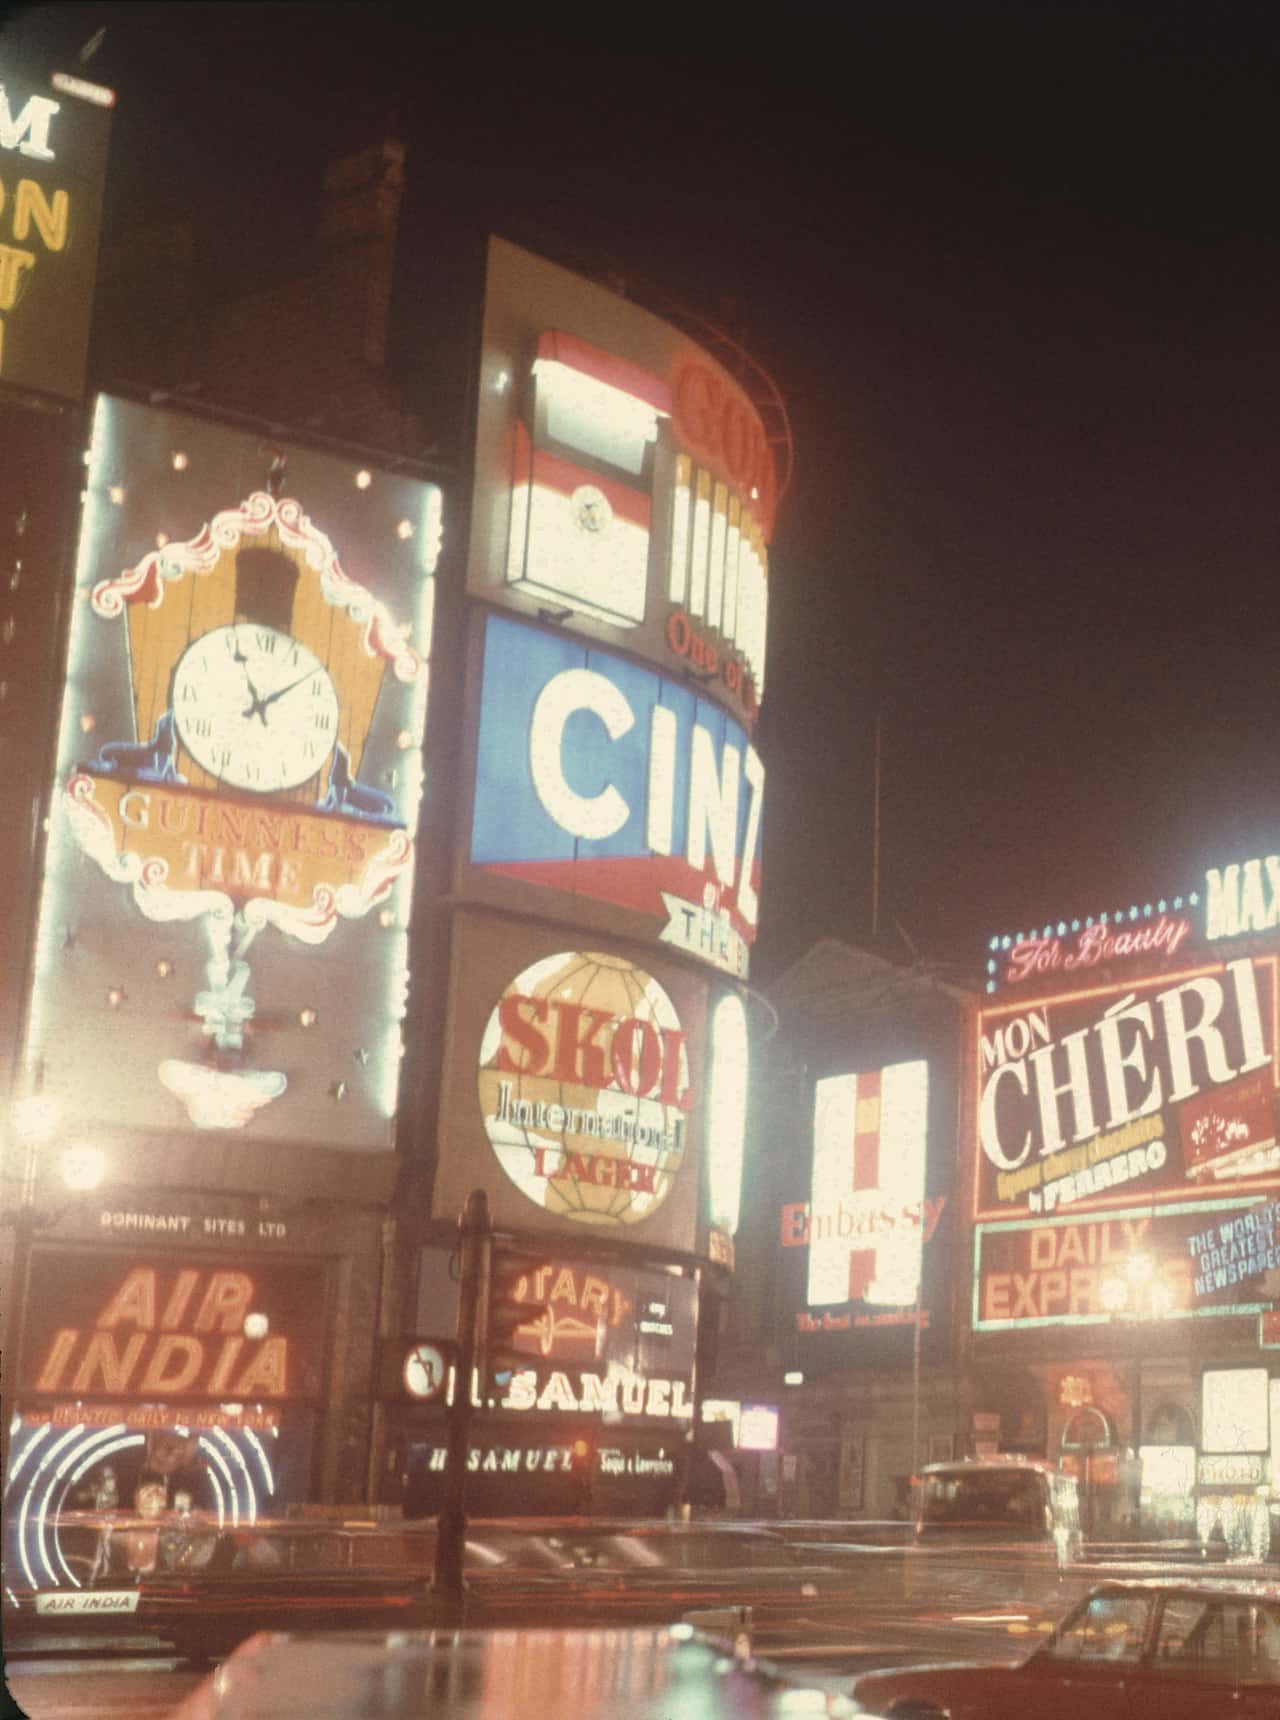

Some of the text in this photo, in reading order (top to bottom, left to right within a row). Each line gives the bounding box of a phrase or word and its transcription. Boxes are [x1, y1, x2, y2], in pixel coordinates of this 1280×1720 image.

[0, 178, 69, 251] N
[668, 610, 718, 673] One
[118, 790, 368, 864] GUINNESS
[182, 841, 302, 893] TIME
[1006, 915, 1190, 982] For Beauty
[496, 994, 694, 1111] SKOL
[979, 958, 1272, 1171] CHÉRI
[980, 1007, 1051, 1073] MON
[534, 1146, 657, 1194] LAGER
[100, 1211, 287, 1238] DOMINANT SITES LTD
[781, 1195, 947, 1248] Embassy
[1030, 1219, 1149, 1269] DAILY
[1187, 1229, 1215, 1257] THE
[1200, 1225, 1275, 1273] GREATEST
[97, 1264, 255, 1333] AIR
[984, 1258, 1193, 1320] EXPRS
[36, 1328, 290, 1397] INDIA
[502, 1370, 694, 1418] SAMUEL
[429, 1448, 448, 1471] H
[467, 1448, 573, 1472] SAMUEL
[45, 1596, 130, 1609] AIR INDIA
